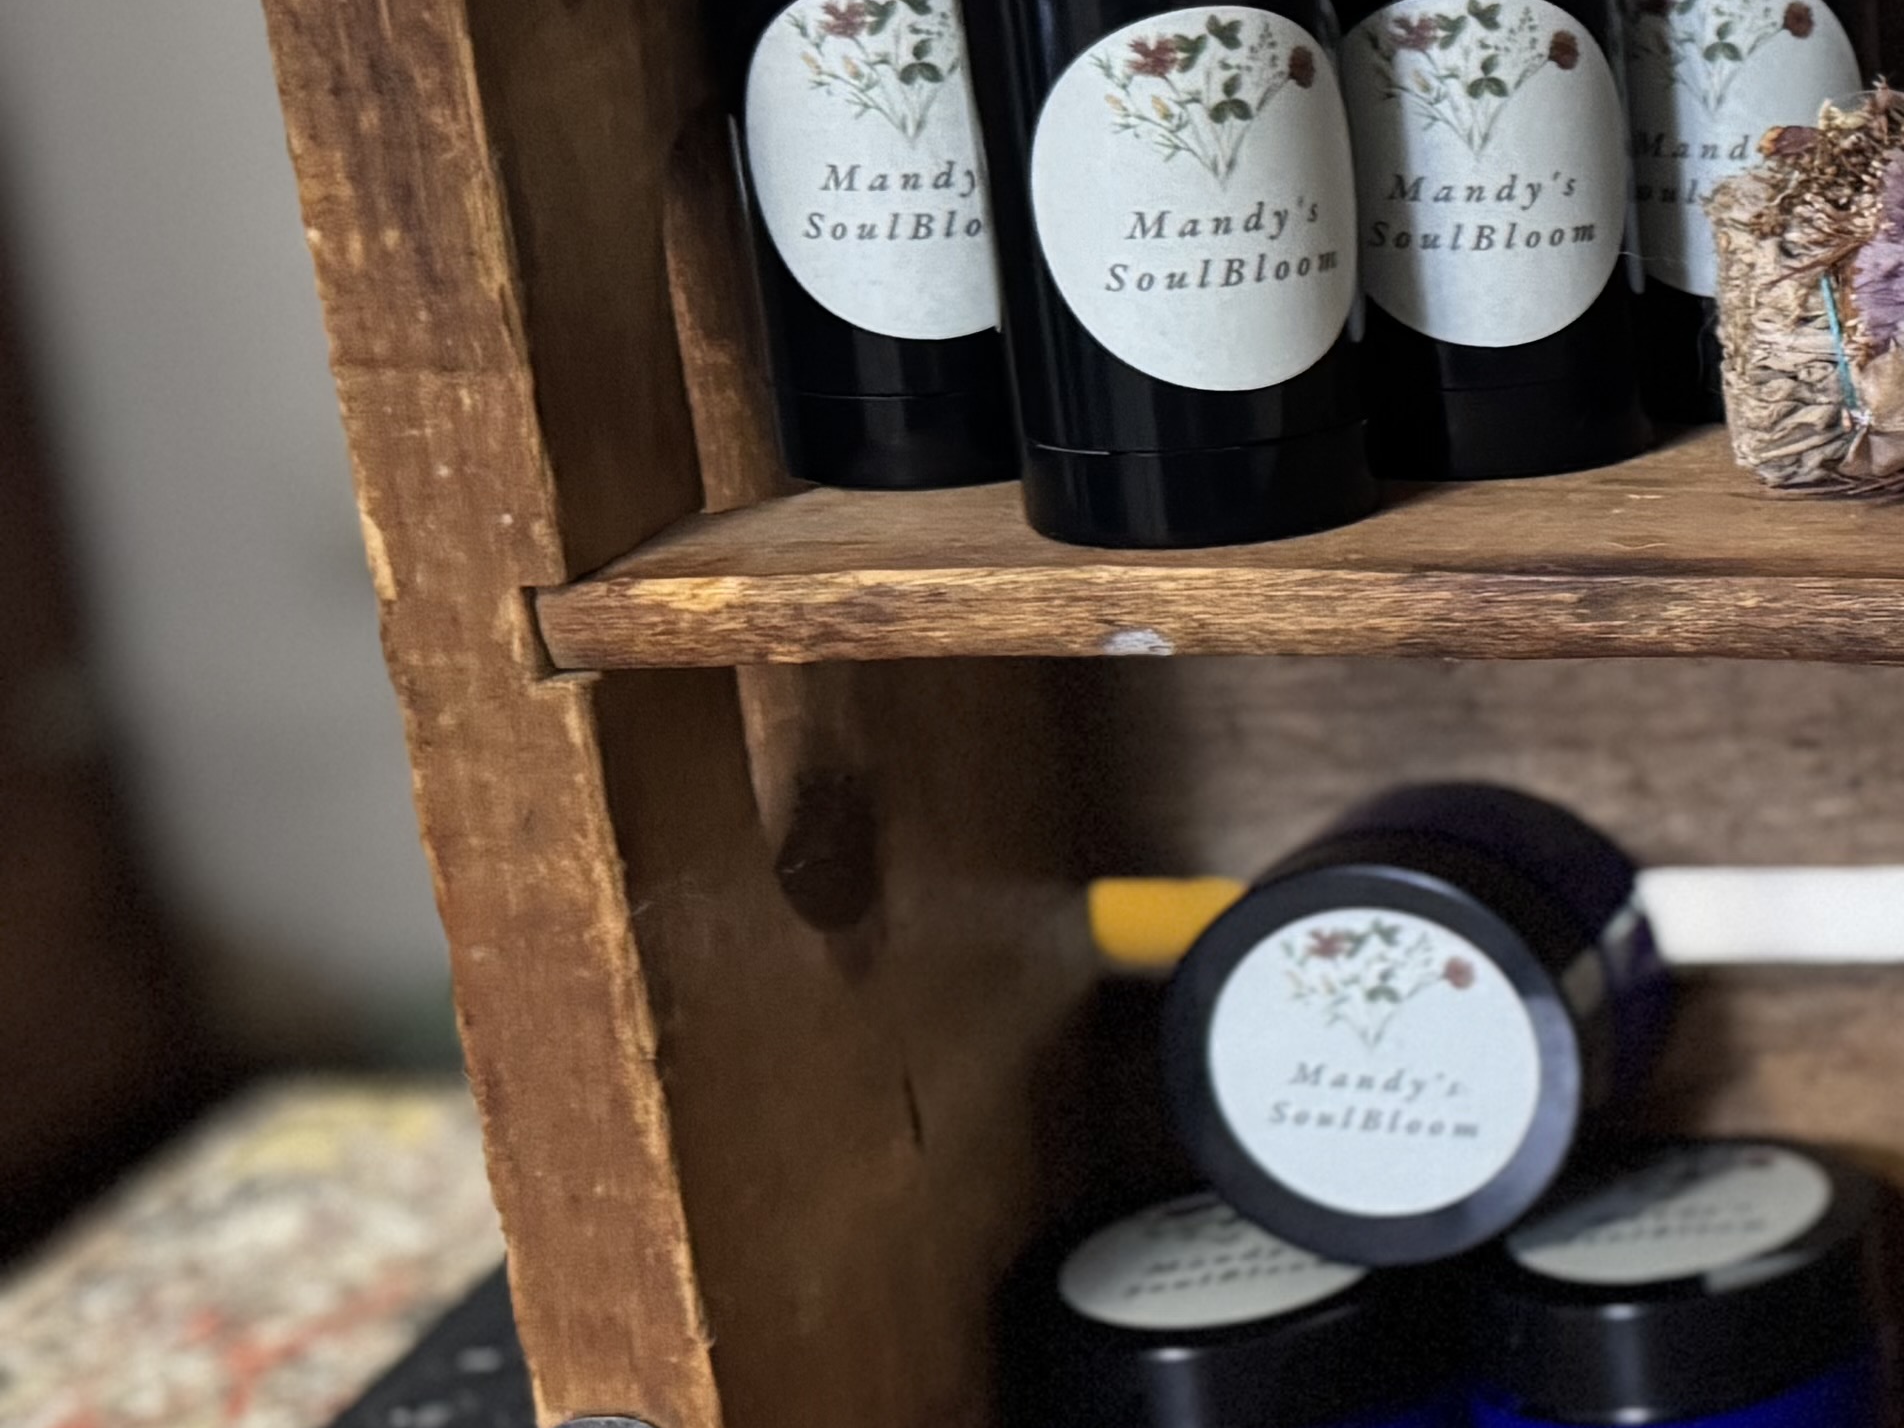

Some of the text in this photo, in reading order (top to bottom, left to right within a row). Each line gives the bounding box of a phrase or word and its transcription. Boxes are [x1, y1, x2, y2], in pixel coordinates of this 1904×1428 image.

[1388, 170, 1577, 211] Mandy's
[1124, 195, 1318, 240] Mandy's
[1368, 220, 1596, 252] SoulBloom
[1104, 250, 1338, 293] SoulBloom
[1288, 1061, 1463, 1103] Mandy's
[1268, 1100, 1480, 1139] SoulBloom
